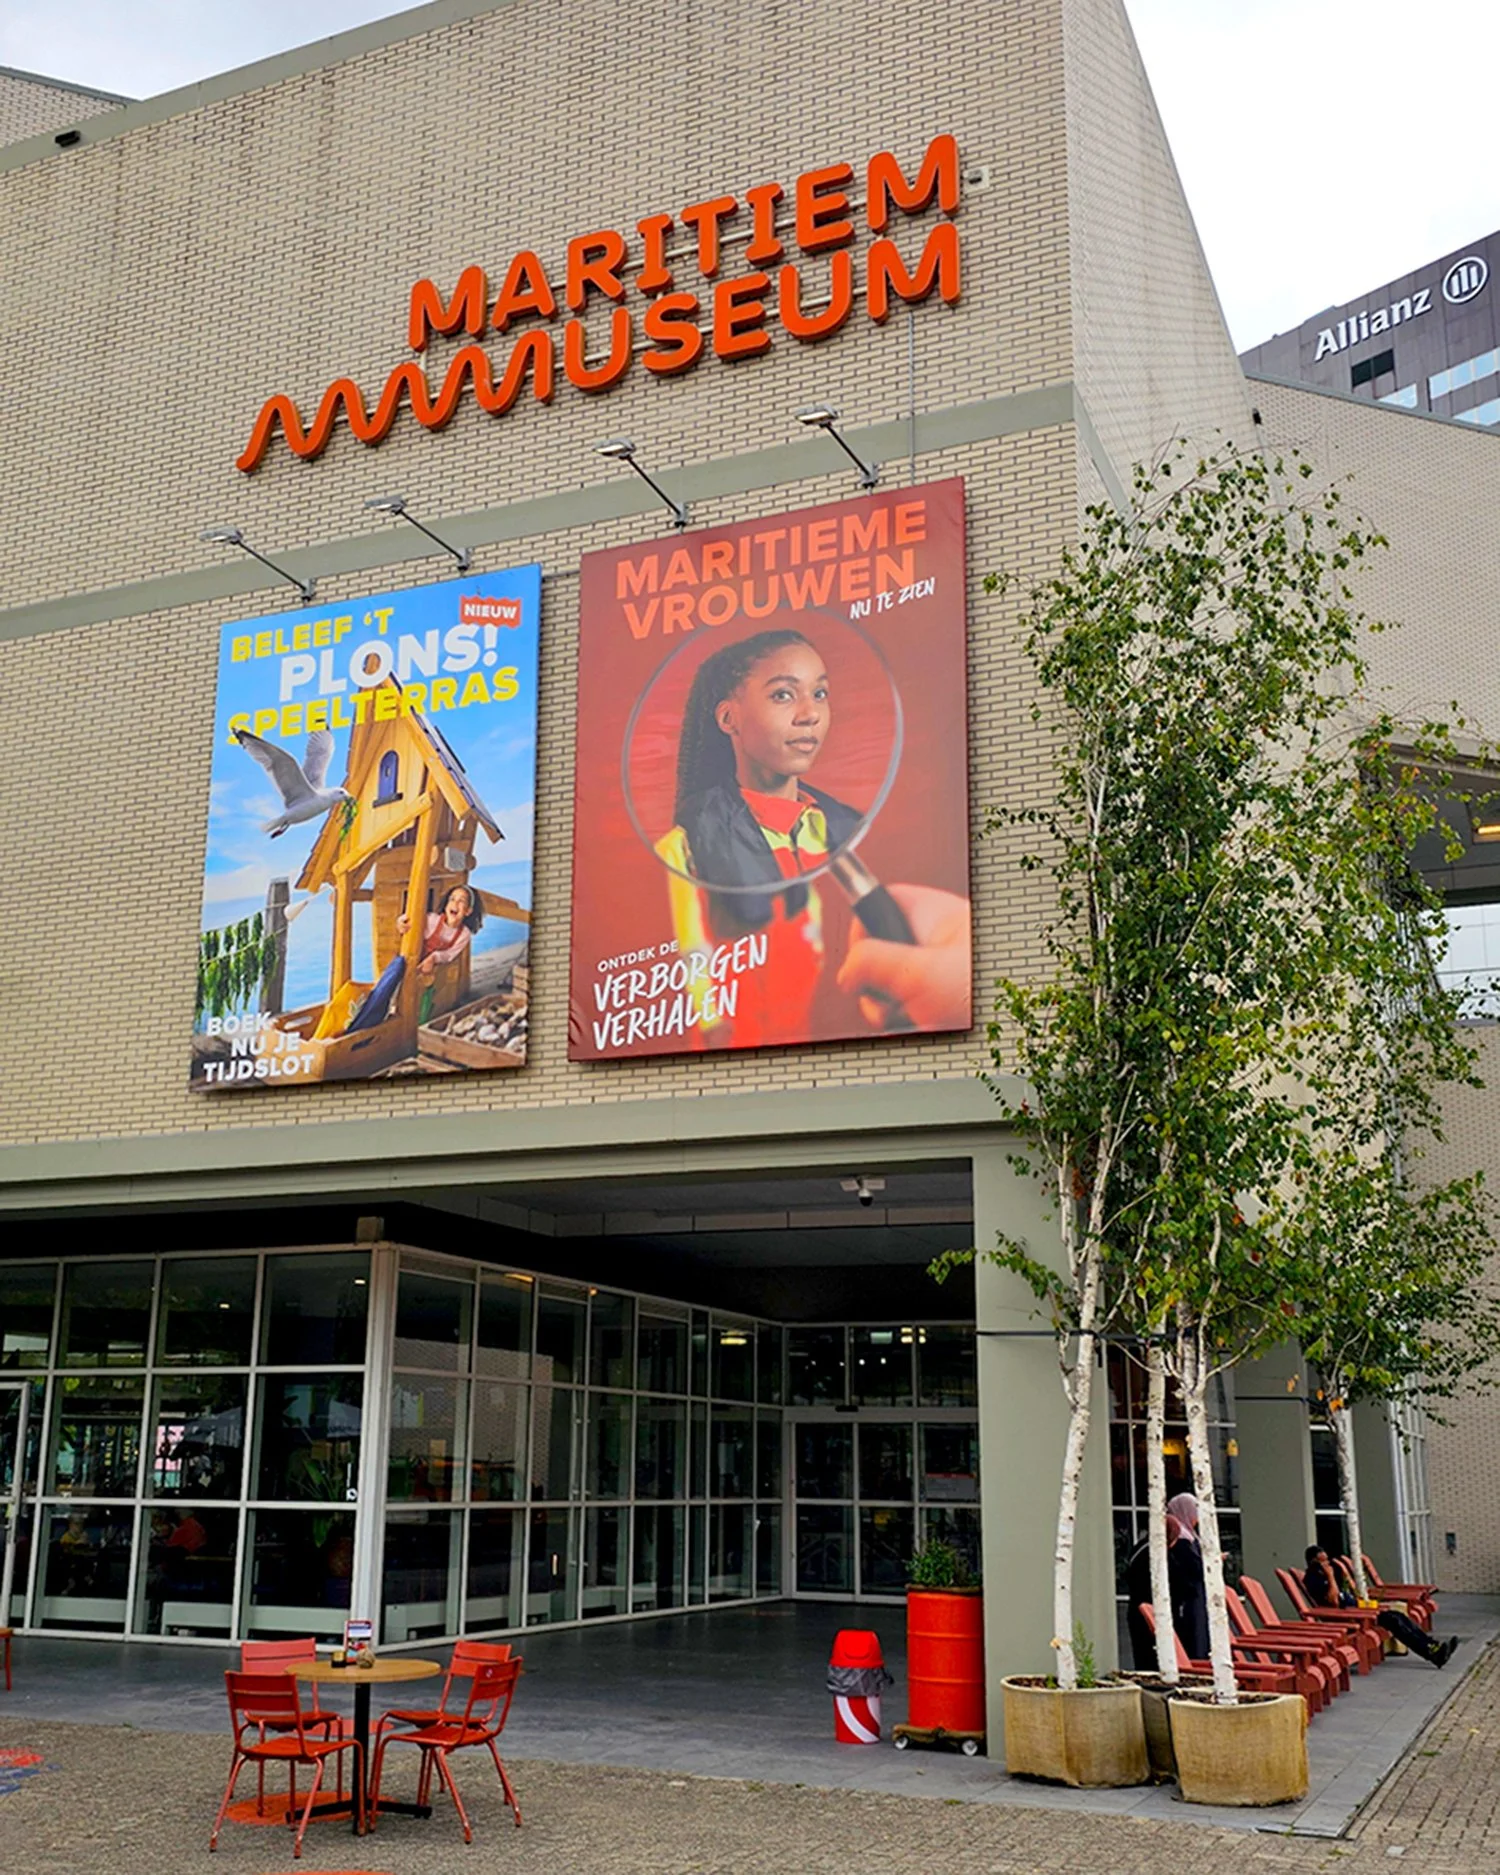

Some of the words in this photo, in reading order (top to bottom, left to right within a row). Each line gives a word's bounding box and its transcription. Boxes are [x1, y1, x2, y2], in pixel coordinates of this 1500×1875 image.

[408, 134, 961, 352] MARITIEM
[236, 222, 961, 473] MUSEUM
[1314, 288, 1433, 362] Allianz
[616, 500, 927, 600] MARITIEME
[464, 603, 517, 620] NIEUW
[622, 549, 915, 640] VROUWEN
[850, 598, 872, 620] NU
[876, 591, 894, 613] TE
[898, 576, 936, 605] ZIEN
[231, 615, 353, 663] BELEEF
[278, 623, 499, 703] PLONS!
[226, 666, 521, 746] SPEELTERRAS
[593, 933, 768, 1013] VERBORGEN
[597, 945, 657, 974] ONTDEK
[658, 939, 681, 956] DE
[206, 1011, 274, 1037] BOEK
[230, 1035, 267, 1058] NU
[273, 1031, 302, 1055] JE
[592, 978, 739, 1051] VERHALEN
[203, 1053, 315, 1083] TIJDSLOT
